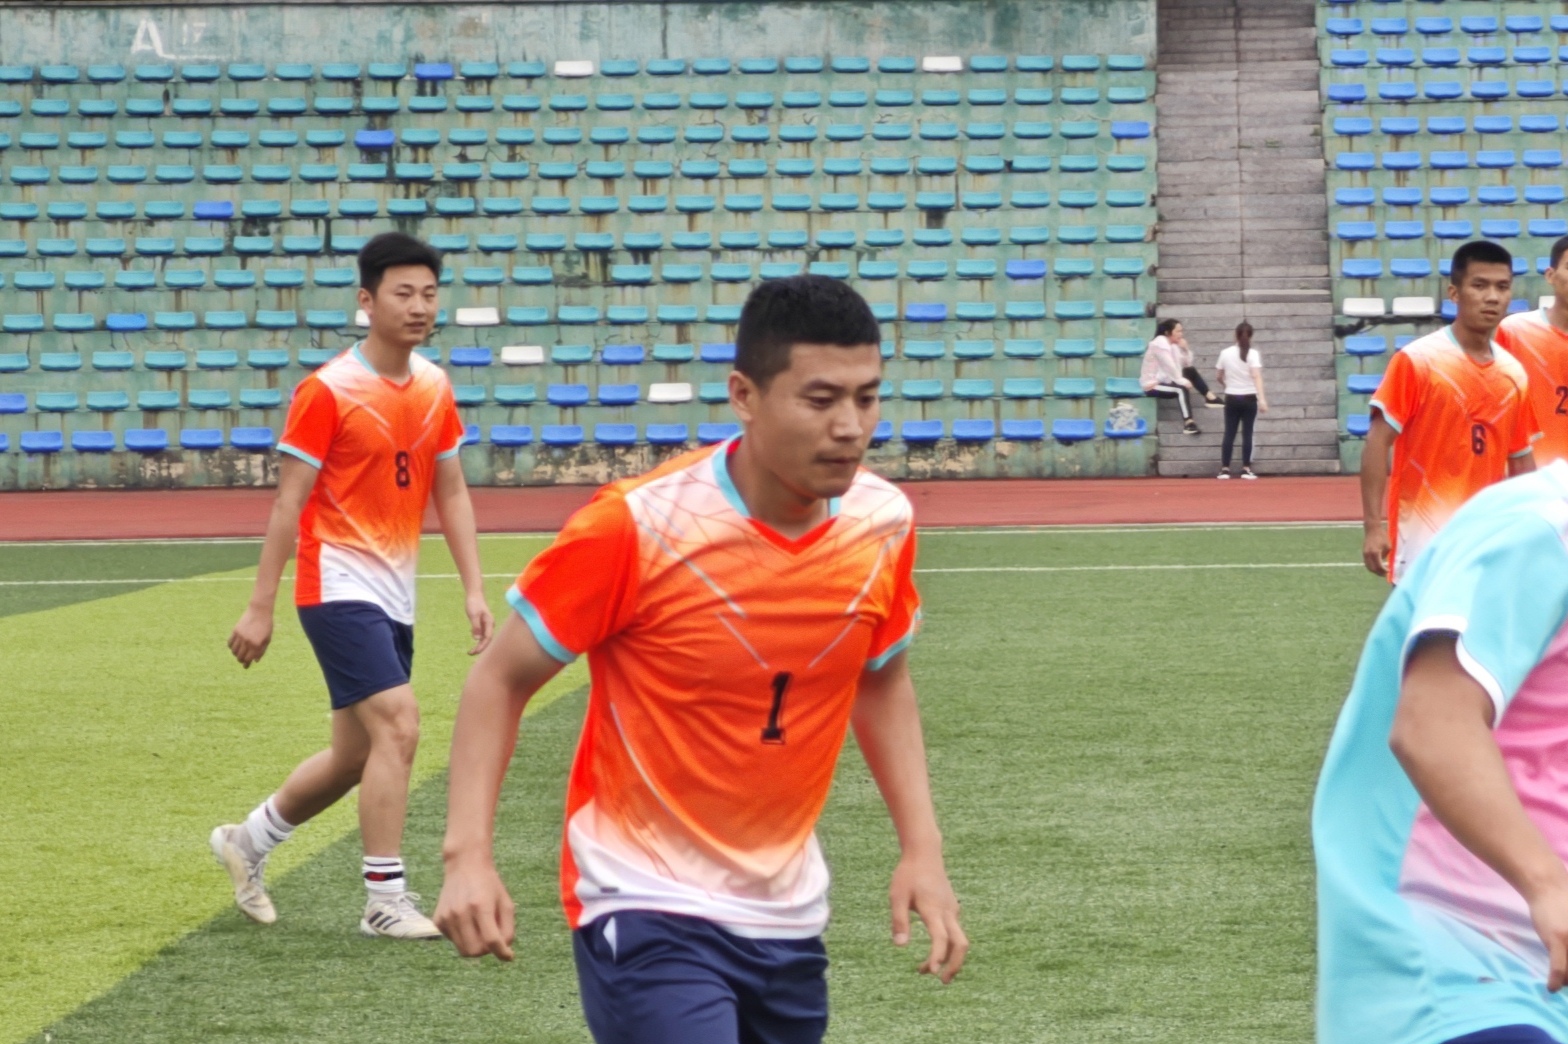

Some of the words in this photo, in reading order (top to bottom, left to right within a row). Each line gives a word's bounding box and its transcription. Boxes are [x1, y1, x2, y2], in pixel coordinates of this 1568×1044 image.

[131, 18, 177, 59] A
[1471, 423, 1486, 455] 6
[395, 450, 411, 488] 8
[761, 671, 794, 745] 1
